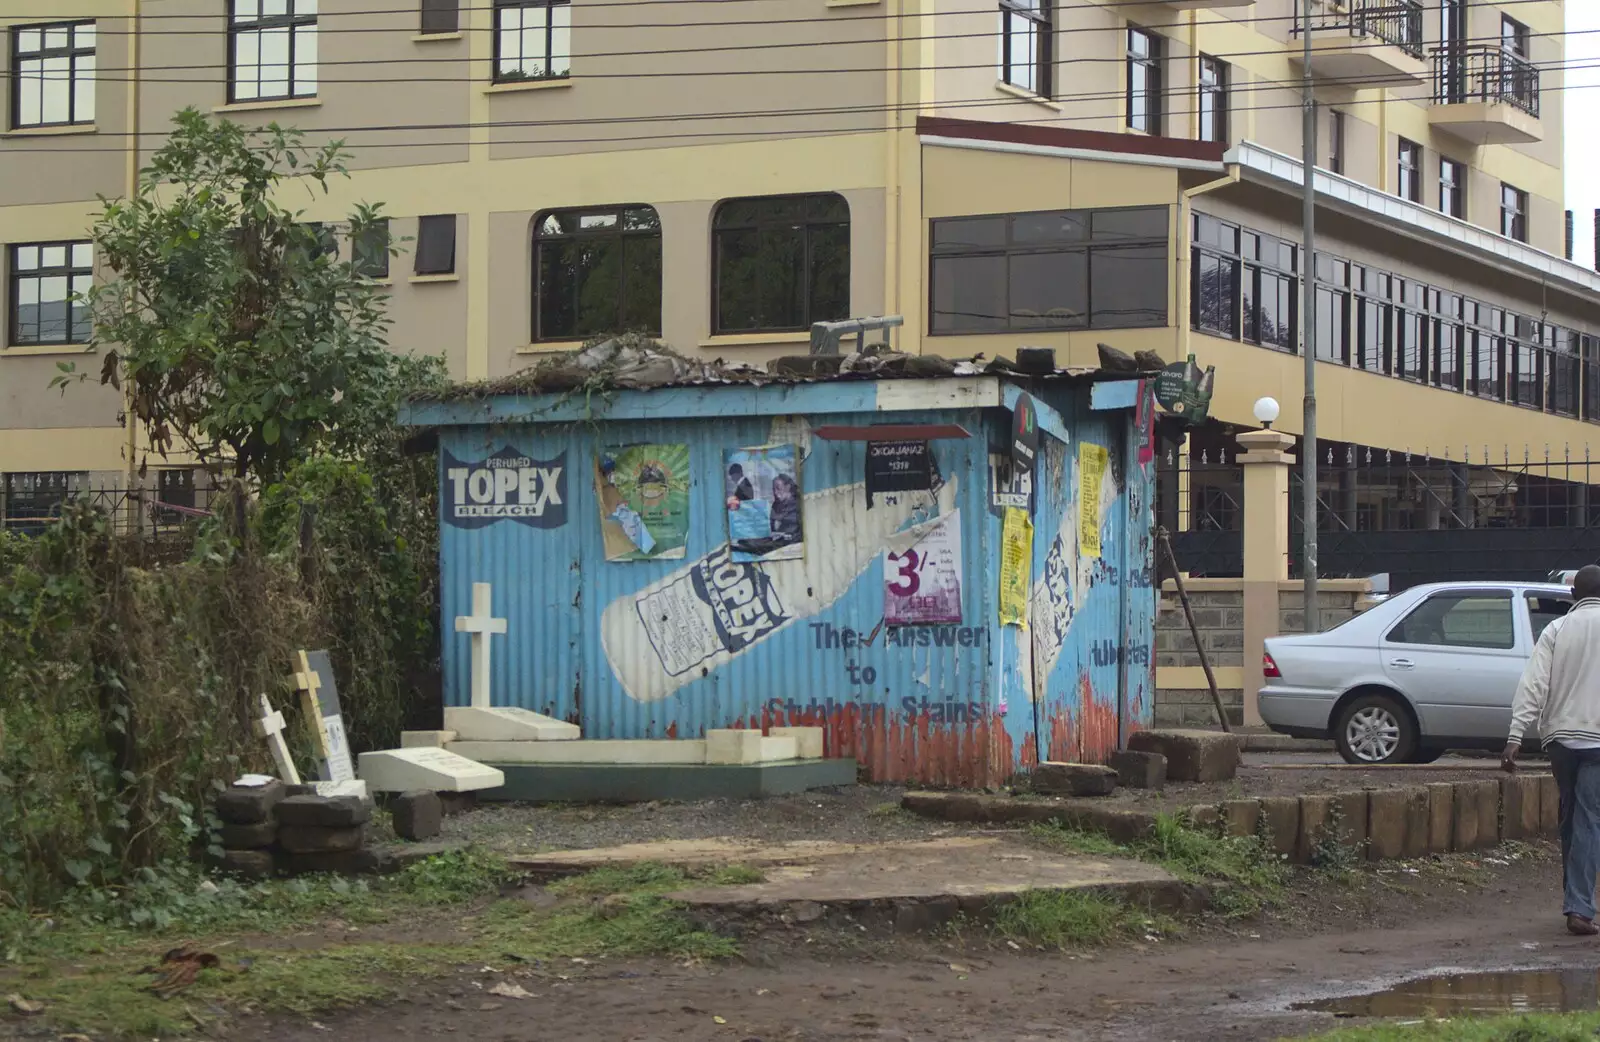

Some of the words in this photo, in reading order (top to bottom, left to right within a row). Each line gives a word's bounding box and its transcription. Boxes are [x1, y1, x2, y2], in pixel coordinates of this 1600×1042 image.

[486, 457, 530, 468] PERFUMED
[448, 467, 563, 505] TOPEX
[459, 506, 537, 515] BLEACH
[809, 622, 857, 649] The
[884, 626, 985, 648] Answer
[846, 659, 877, 685] to
[902, 695, 985, 723] Stains
